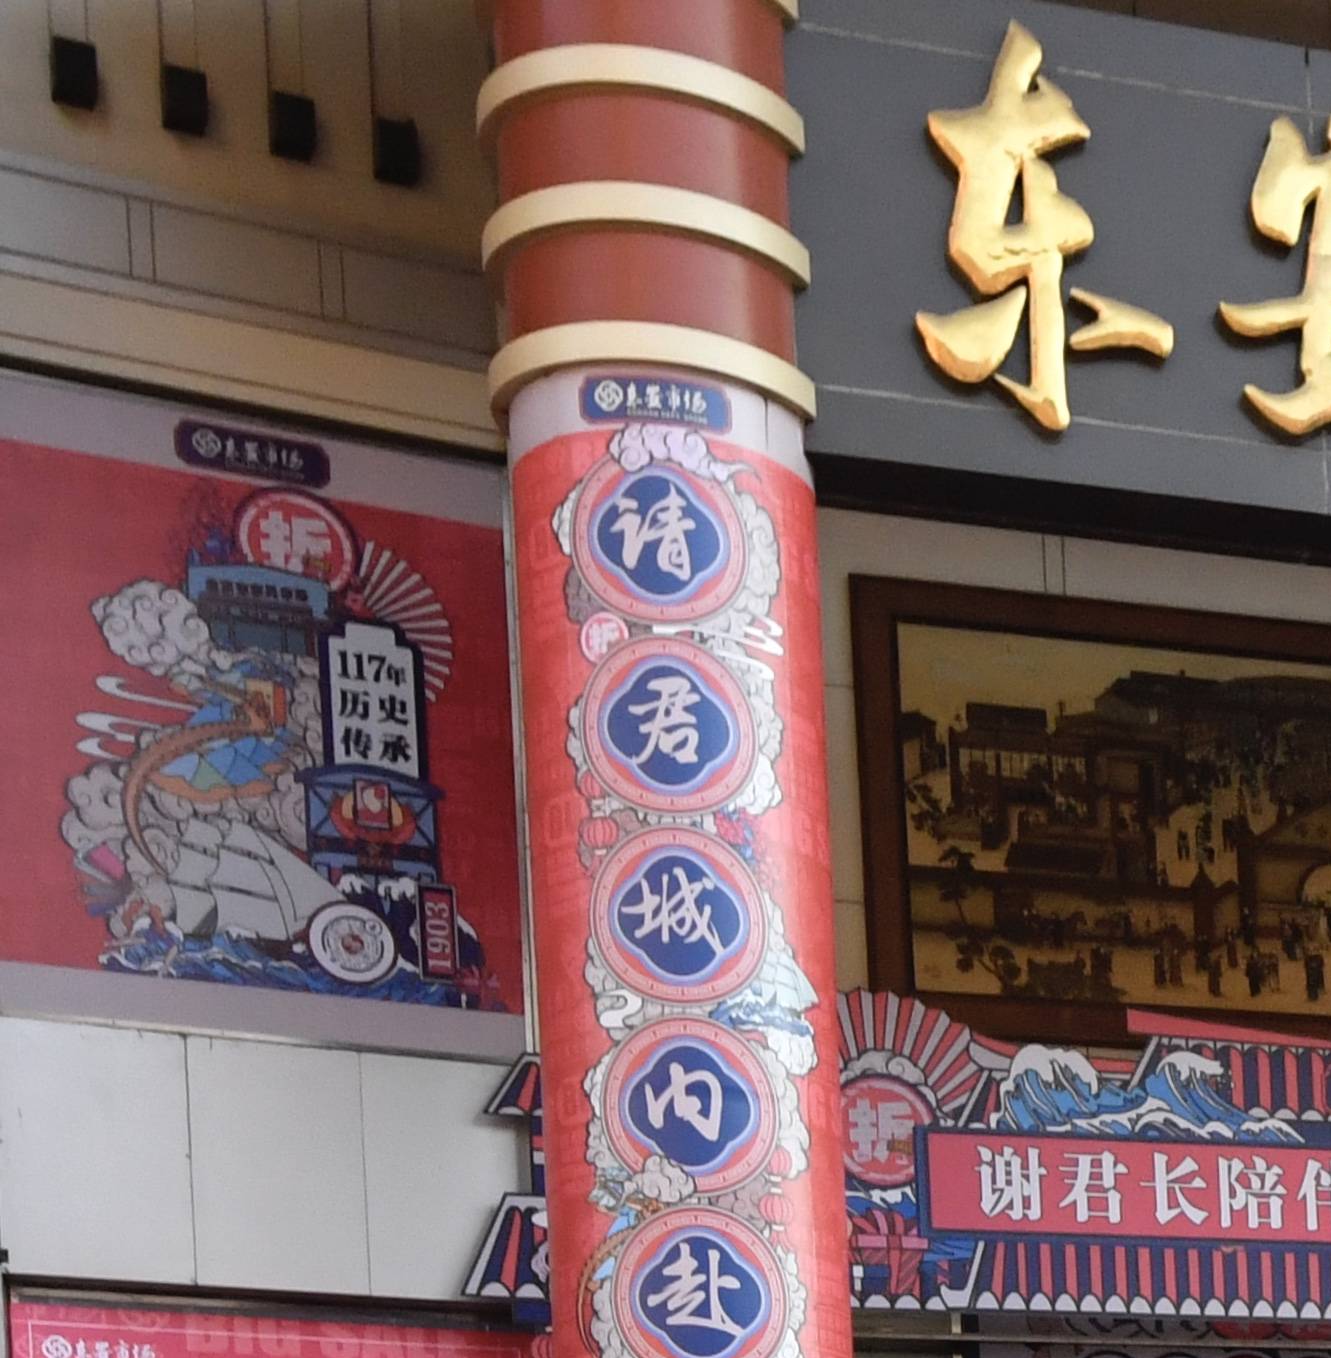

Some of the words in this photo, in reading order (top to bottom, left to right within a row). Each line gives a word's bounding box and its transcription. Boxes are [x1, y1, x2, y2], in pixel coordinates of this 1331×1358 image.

[259, 511, 332, 573] 折
[338, 688, 409, 727] 历史
[340, 726, 412, 764] 传承
[424, 901, 451, 976] 1903
